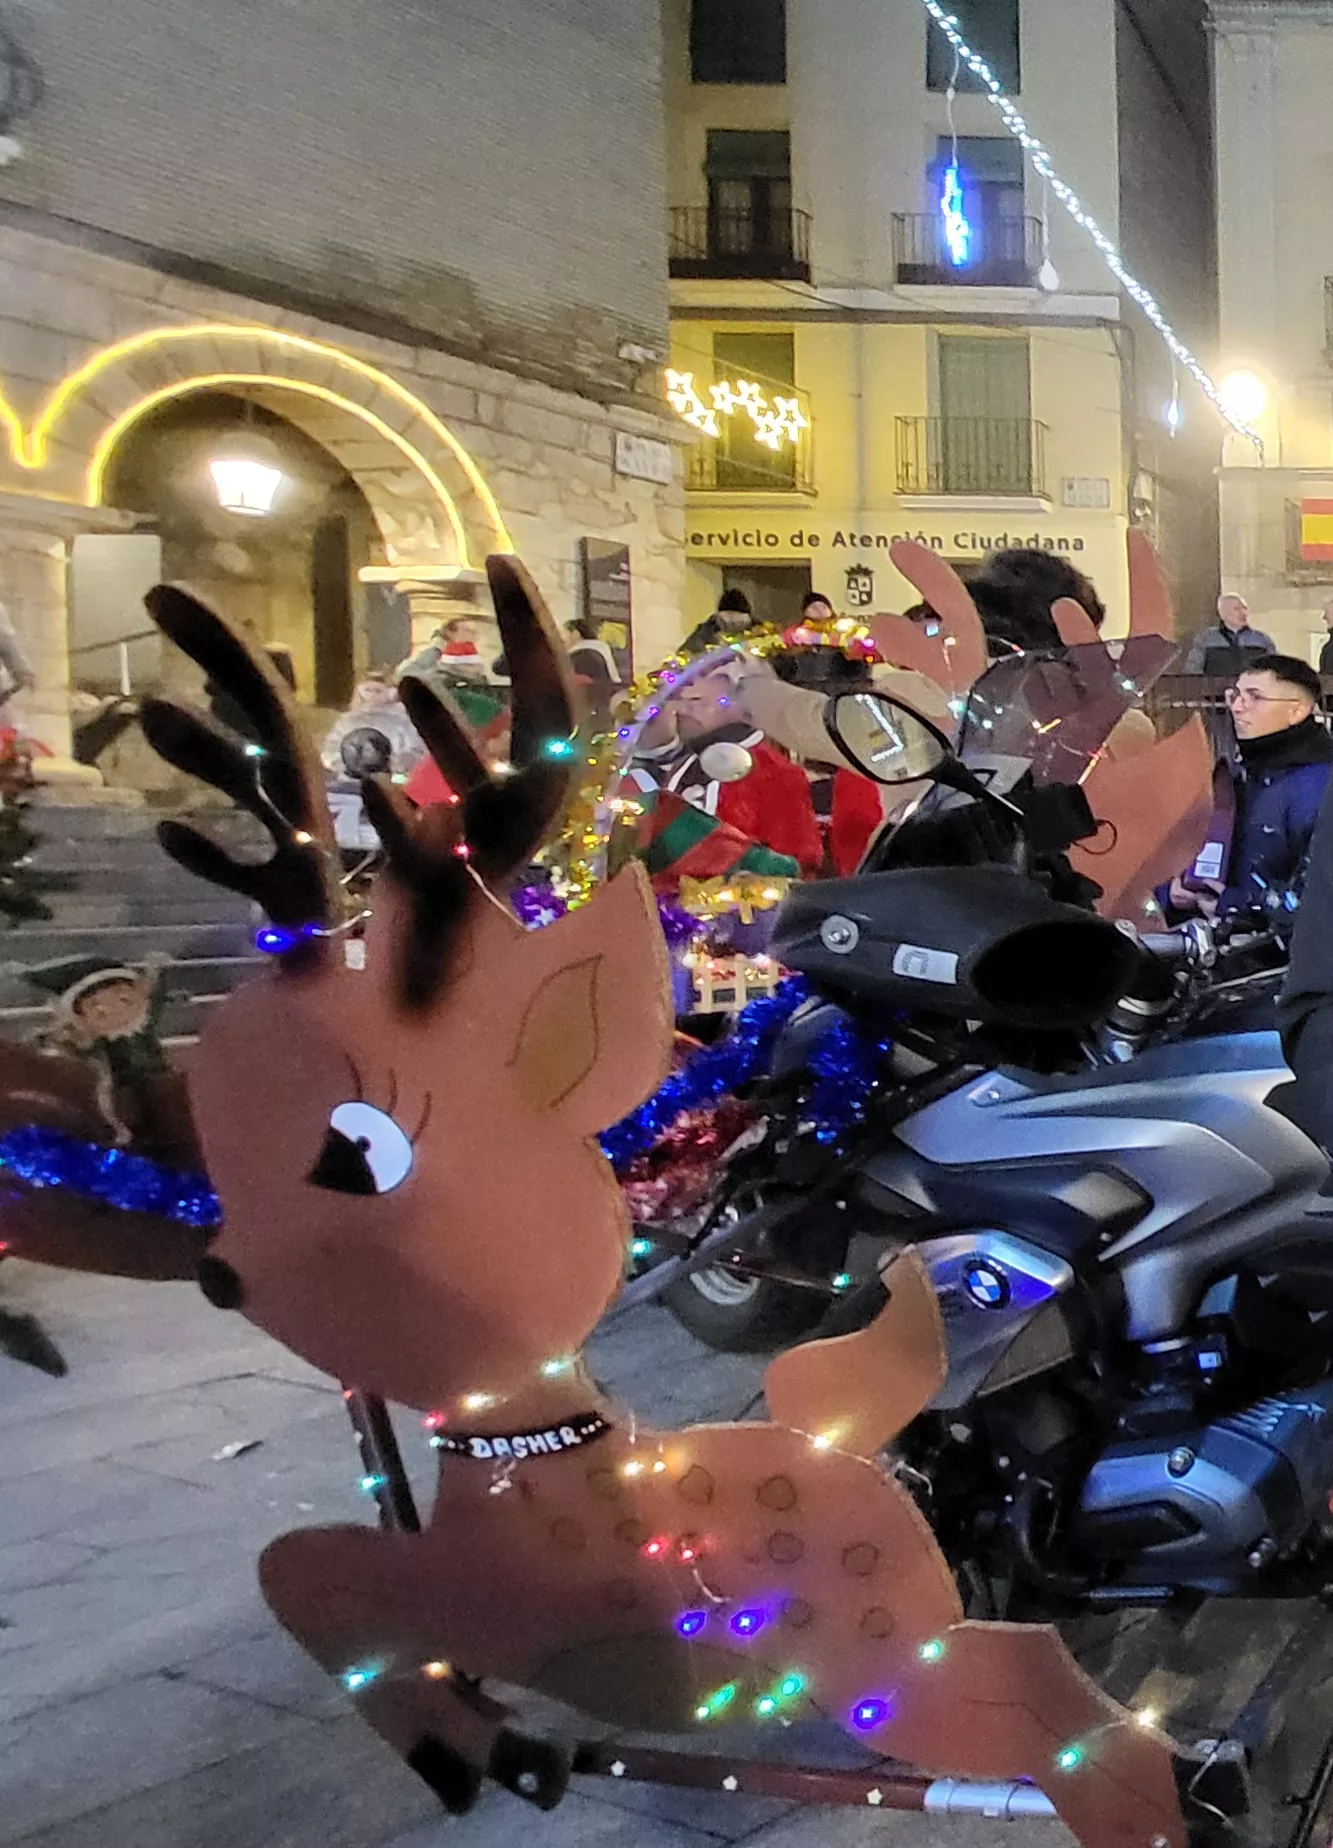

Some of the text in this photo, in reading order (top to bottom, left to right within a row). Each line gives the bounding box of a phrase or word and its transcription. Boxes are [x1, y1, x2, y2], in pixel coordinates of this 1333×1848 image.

[685, 528, 780, 547] ervicio
[789, 529, 821, 547] de
[953, 532, 1085, 551] Ciudadana
[468, 1426, 583, 1458] DASHER
